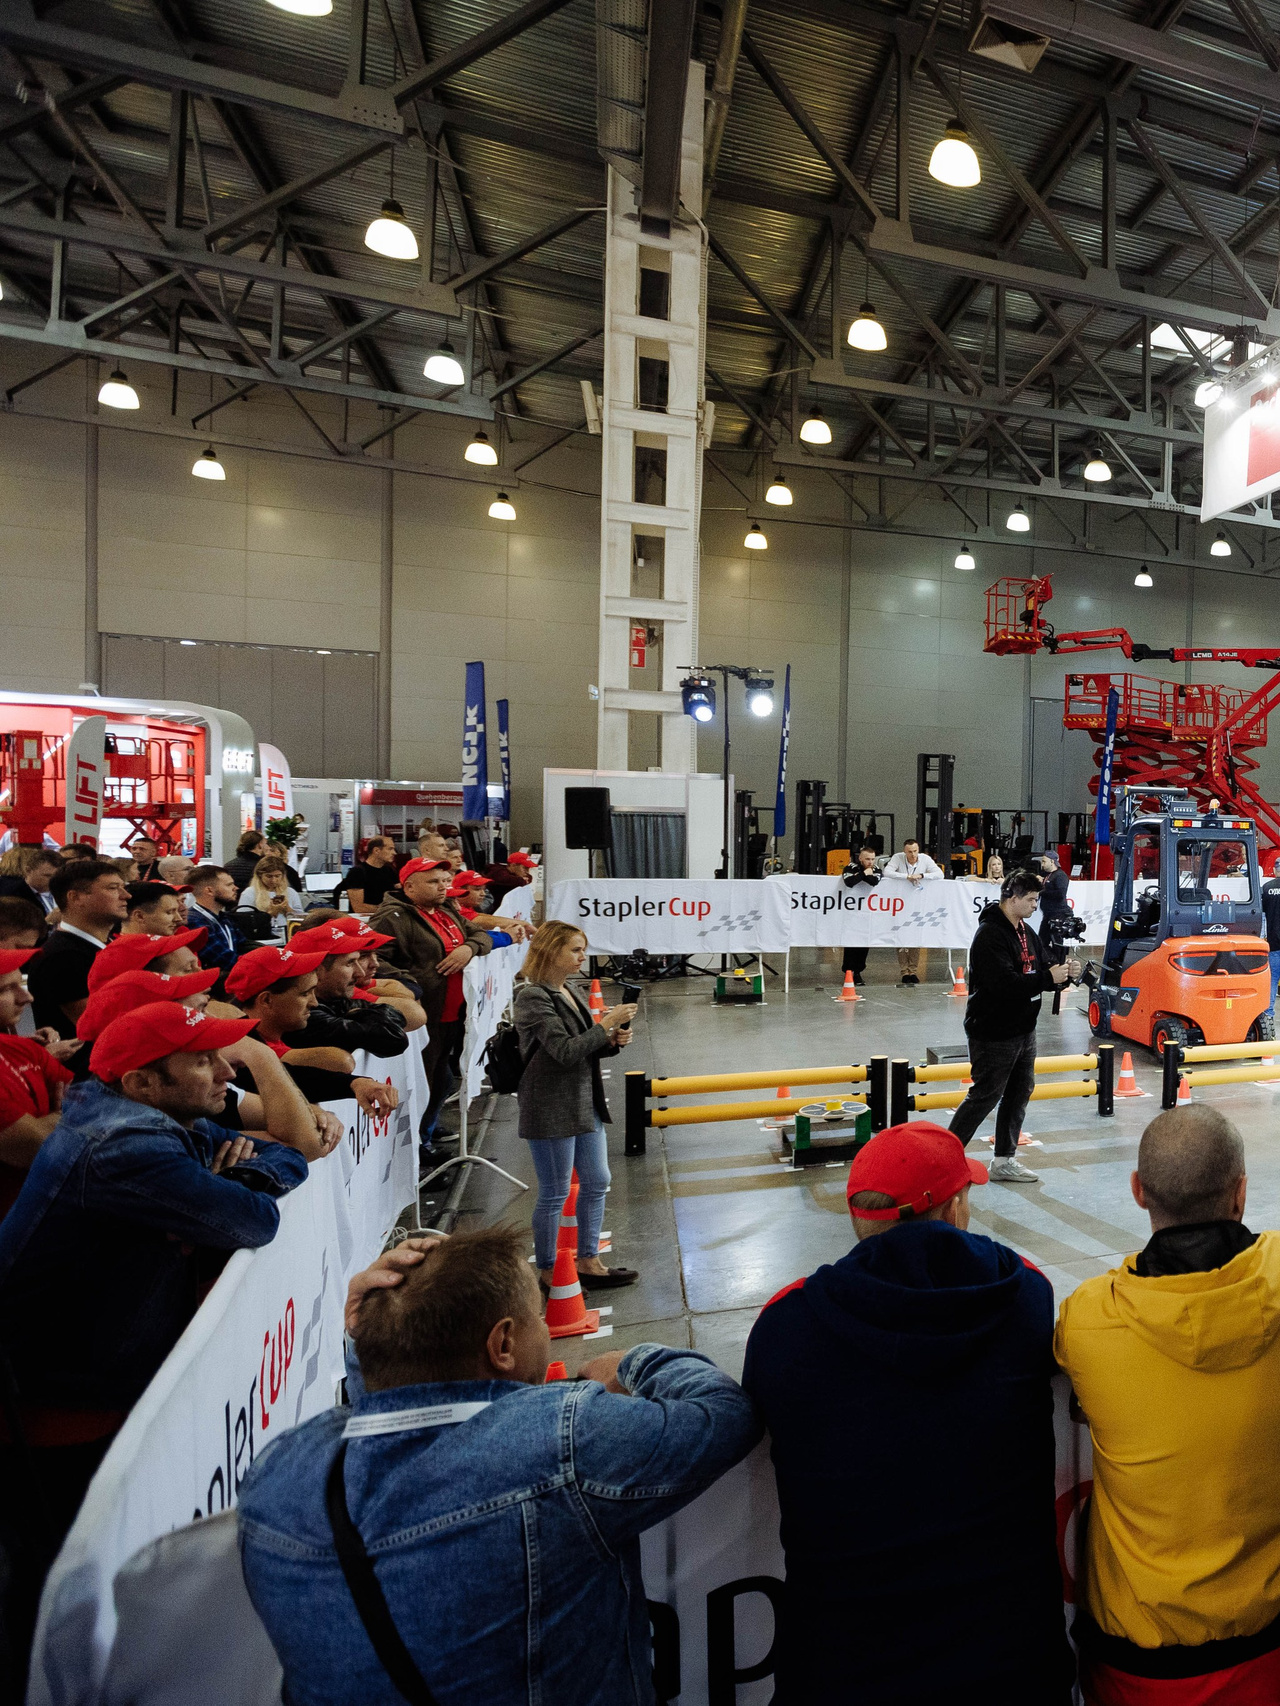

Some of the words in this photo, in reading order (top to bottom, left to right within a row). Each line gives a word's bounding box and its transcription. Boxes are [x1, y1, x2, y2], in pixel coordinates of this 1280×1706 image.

[74, 752, 99, 825] LIFT
[267, 767, 286, 812] LIFT
[578, 895, 711, 922] StaplerCup
[1202, 923, 1229, 933] Linde
